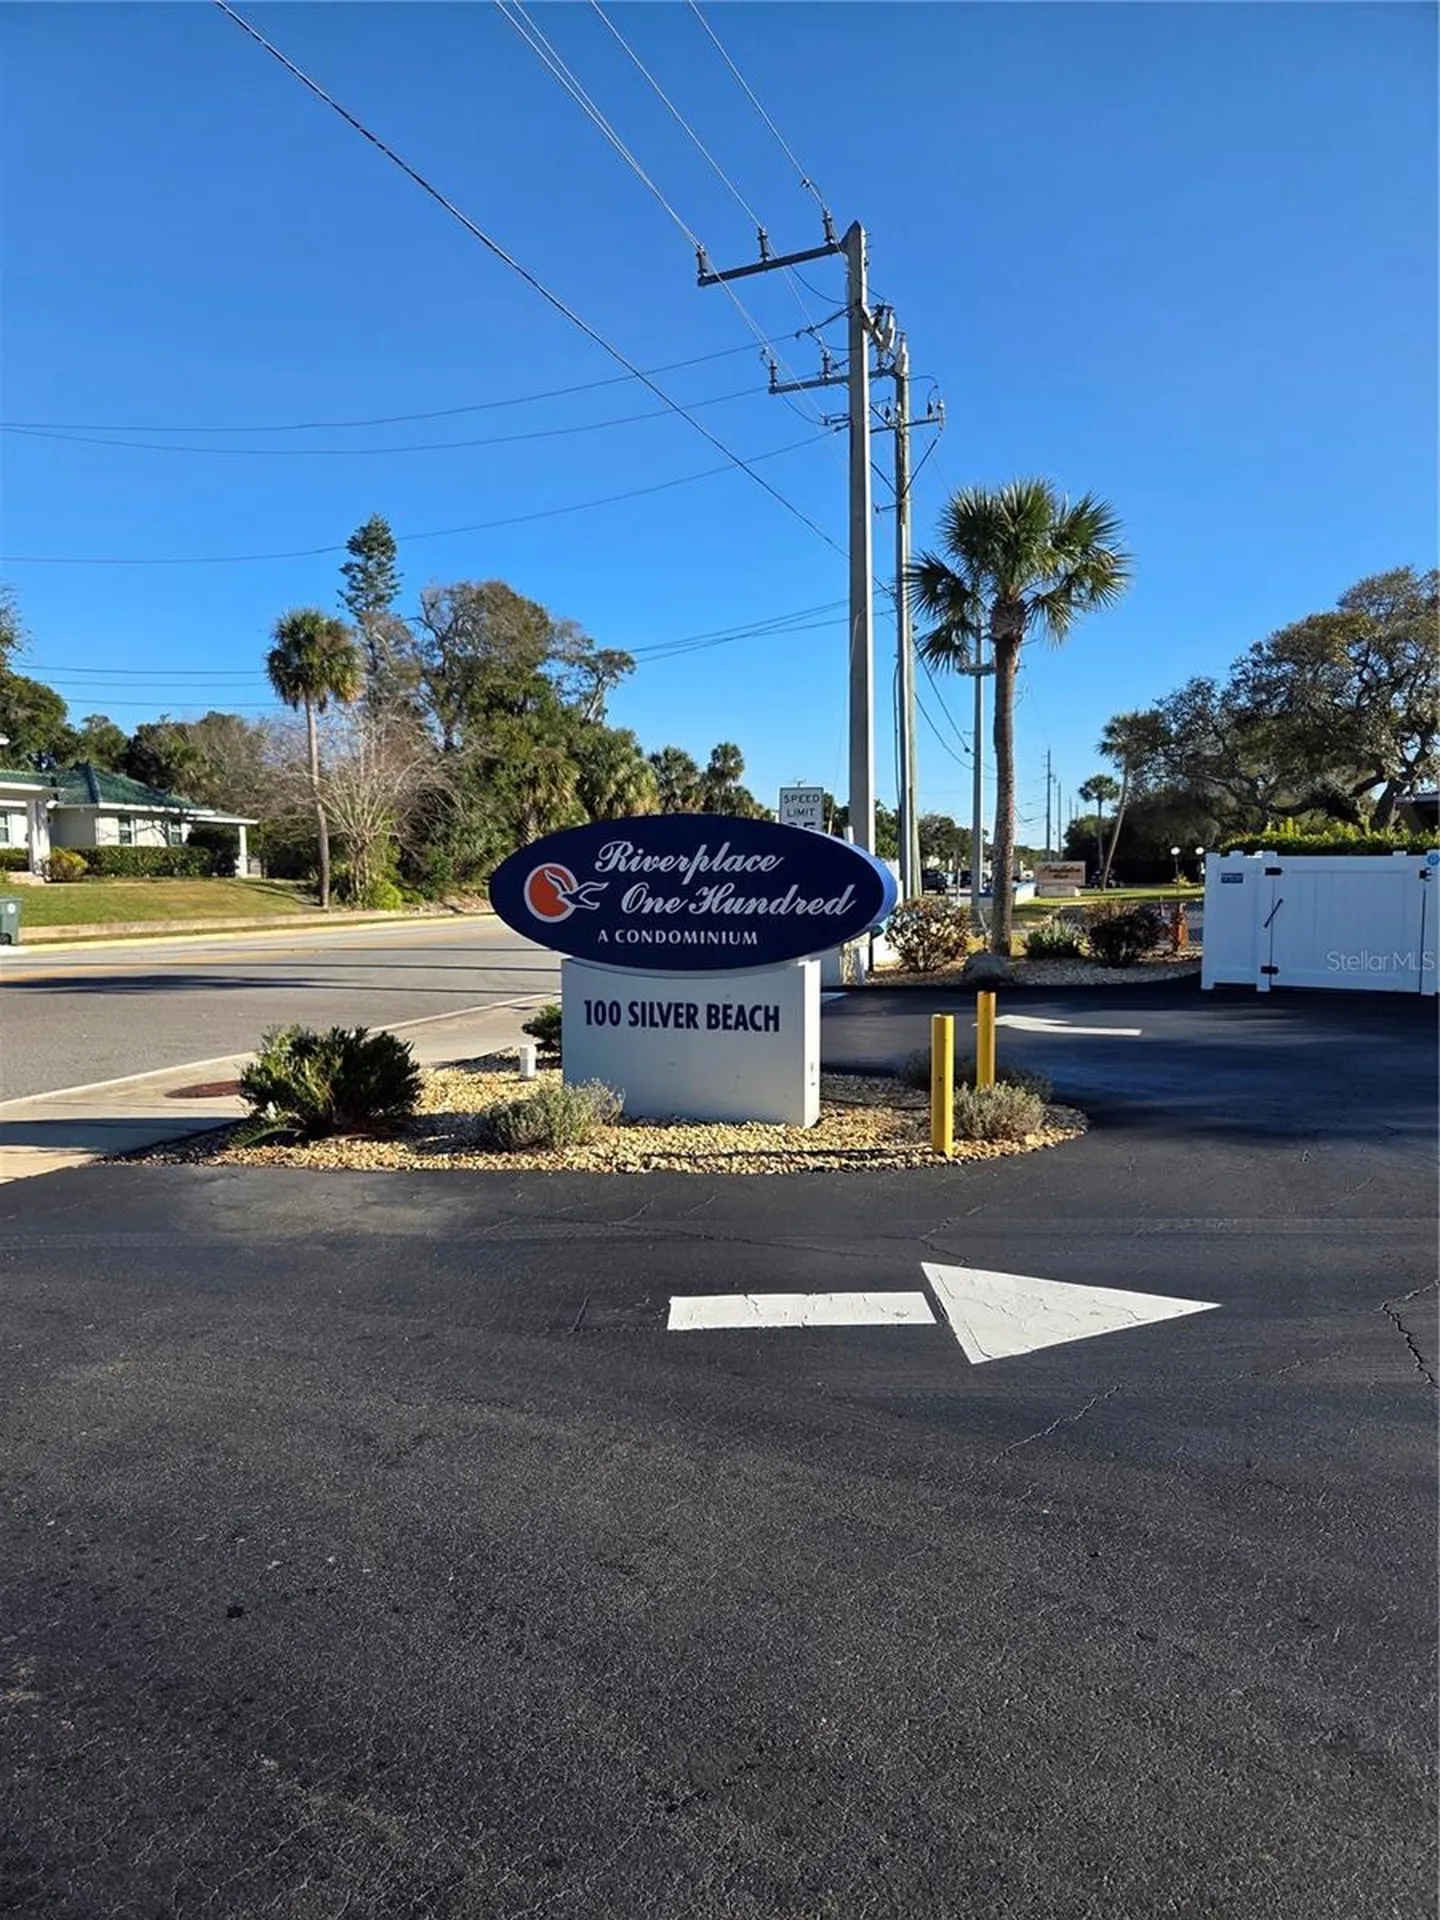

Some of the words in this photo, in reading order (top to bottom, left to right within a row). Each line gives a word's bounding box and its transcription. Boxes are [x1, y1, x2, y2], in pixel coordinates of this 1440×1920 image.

[783, 794, 820, 804] SPEED
[786, 807, 815, 817] LIMIT
[594, 840, 785, 885] Riverplace
[621, 881, 688, 914] One
[688, 882, 857, 916] Hundred
[598, 929, 609, 943] A
[615, 929, 758, 945] CONDOMINIUM
[584, 999, 622, 1027] 100
[628, 1001, 699, 1029] SILVER
[706, 1003, 780, 1032] BEACH
